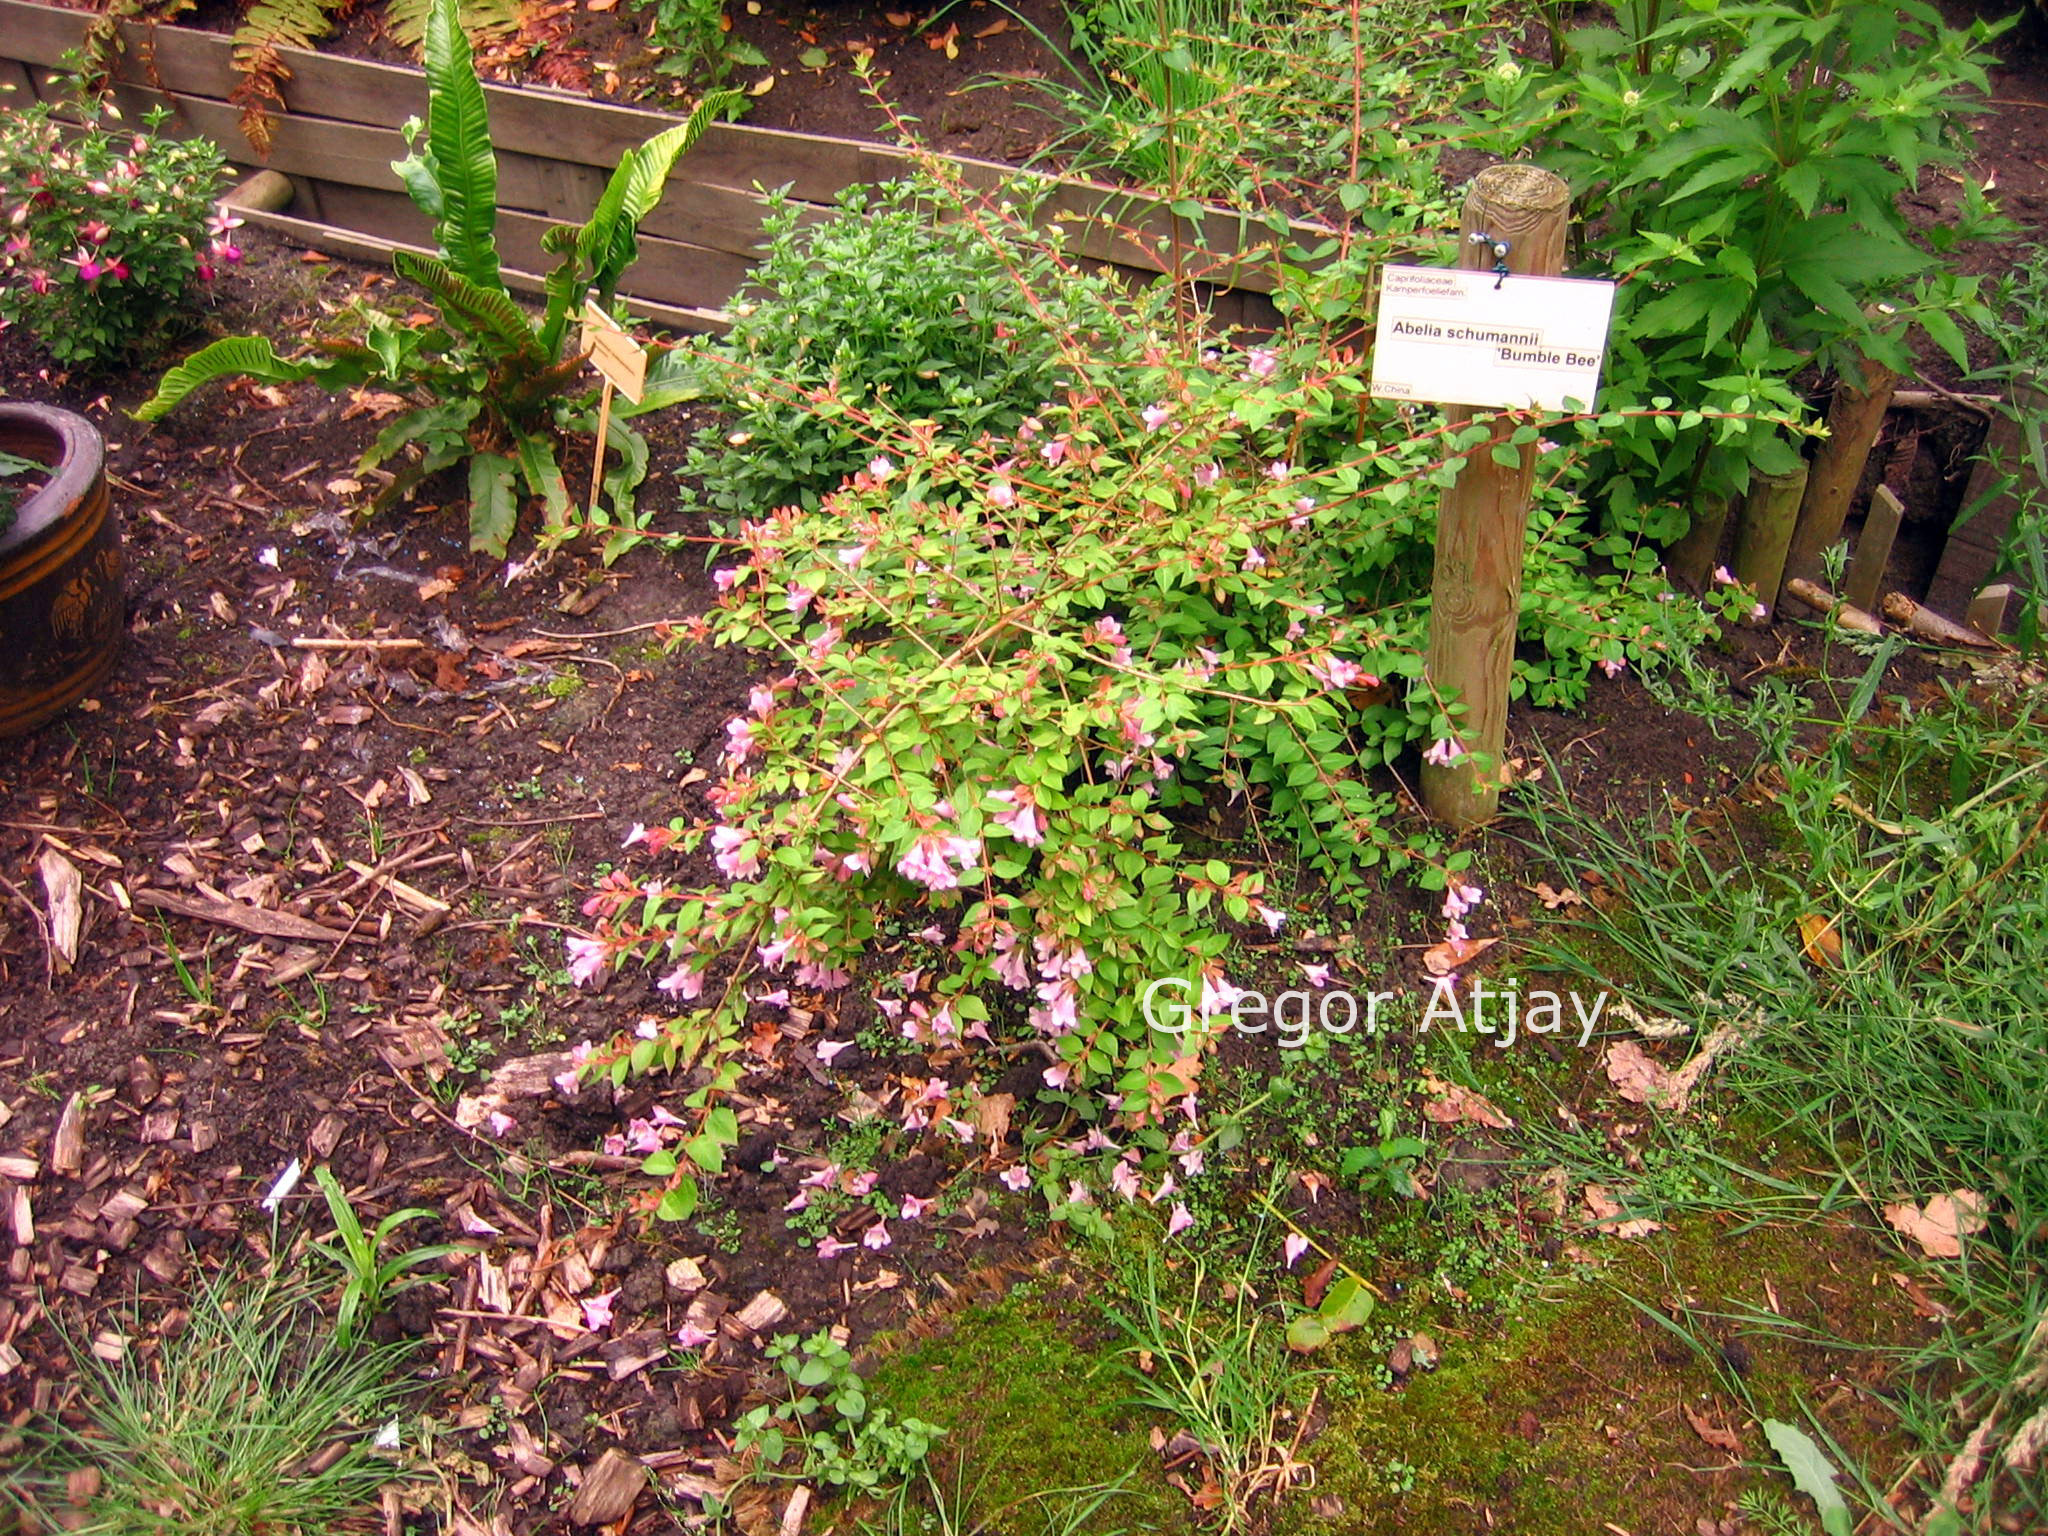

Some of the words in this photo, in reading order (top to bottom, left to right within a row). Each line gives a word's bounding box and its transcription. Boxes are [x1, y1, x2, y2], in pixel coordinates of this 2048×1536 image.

[1387, 272, 1454, 286] Caprifoliaceae
[1392, 321, 1442, 338] Abelia
[1447, 326, 1540, 347] schumannii
[1497, 347, 1561, 365] 'Bumble
[1566, 352, 1601, 368] Bee'
